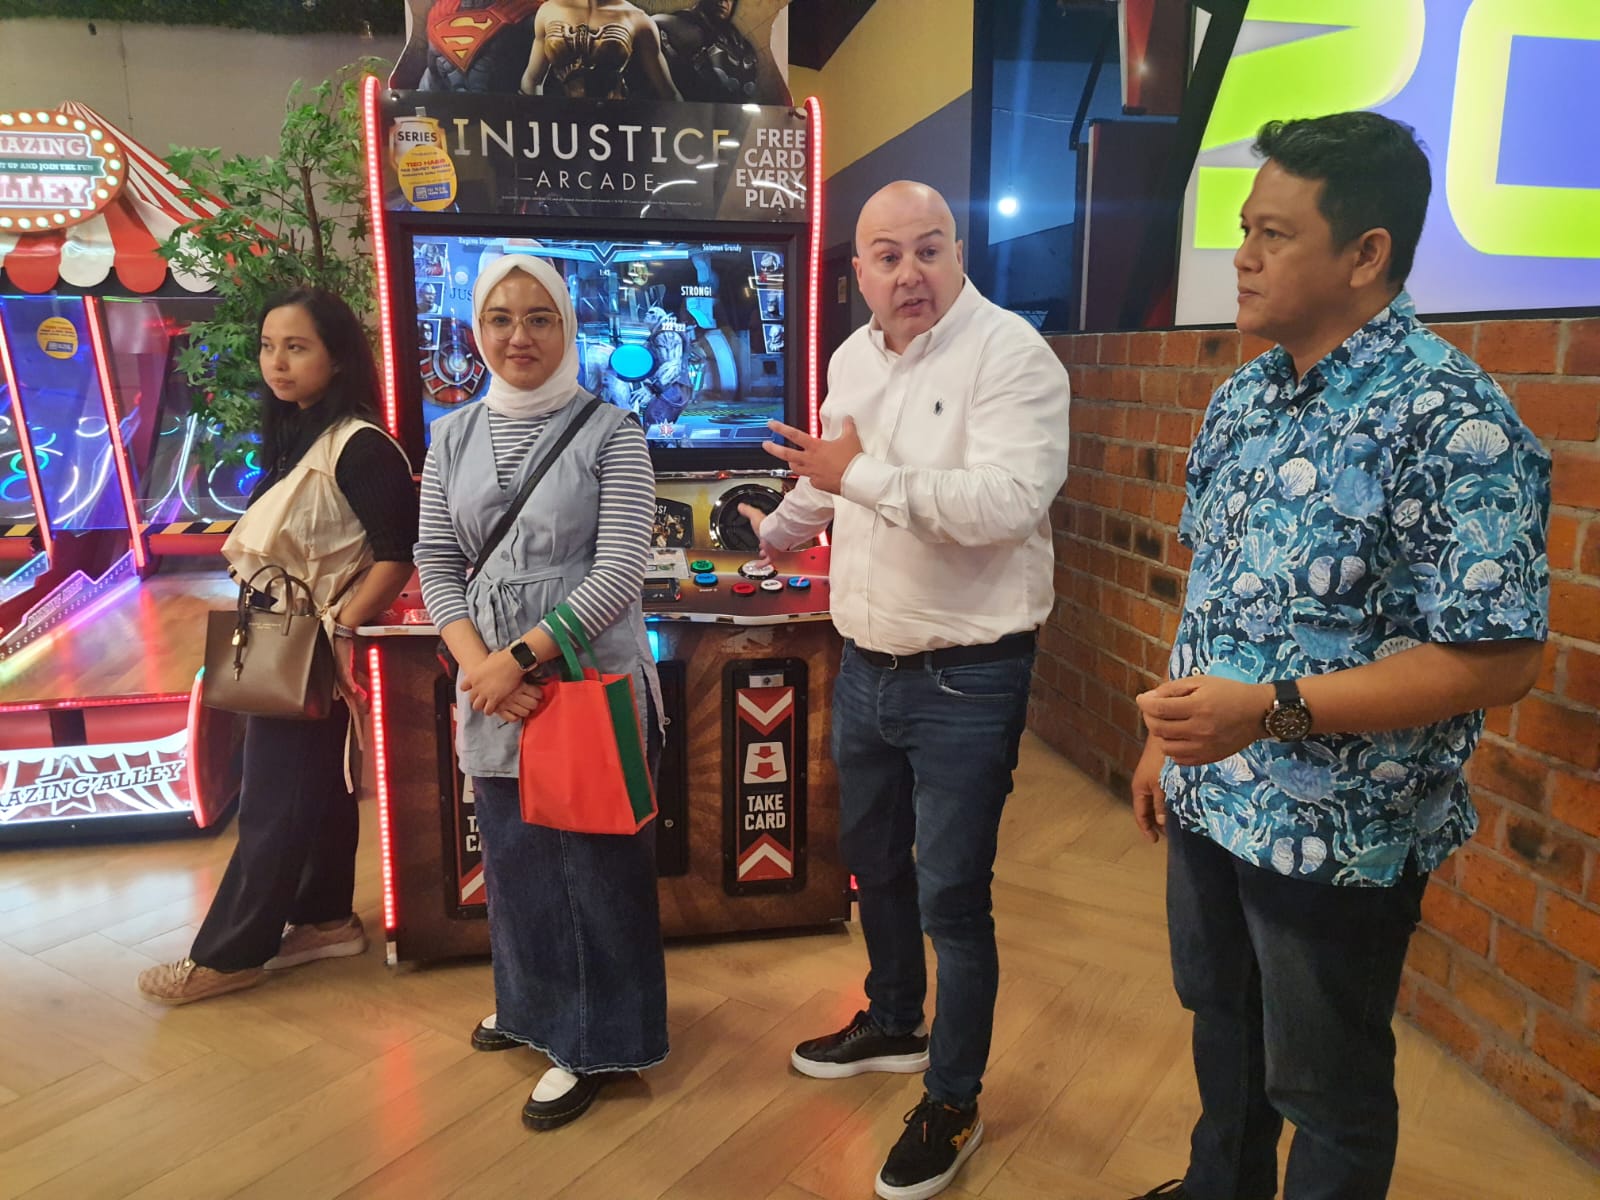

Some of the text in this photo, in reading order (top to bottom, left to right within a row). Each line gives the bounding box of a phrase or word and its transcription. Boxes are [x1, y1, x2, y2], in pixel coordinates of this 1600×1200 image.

[397, 130, 438, 144] SERIES
[453, 118, 730, 166] INJUSTICE
[756, 128, 807, 149] FREE
[20, 162, 38, 170] AND
[744, 148, 806, 169] CARD
[536, 170, 654, 192] ARCADE
[736, 168, 806, 188] EVERY
[745, 188, 807, 210] PLAY!
[680, 285, 713, 297] STRONG!
[0, 762, 183, 808] AZING ALLEY
[746, 793, 784, 813] TAKE
[744, 812, 787, 831] CARD
